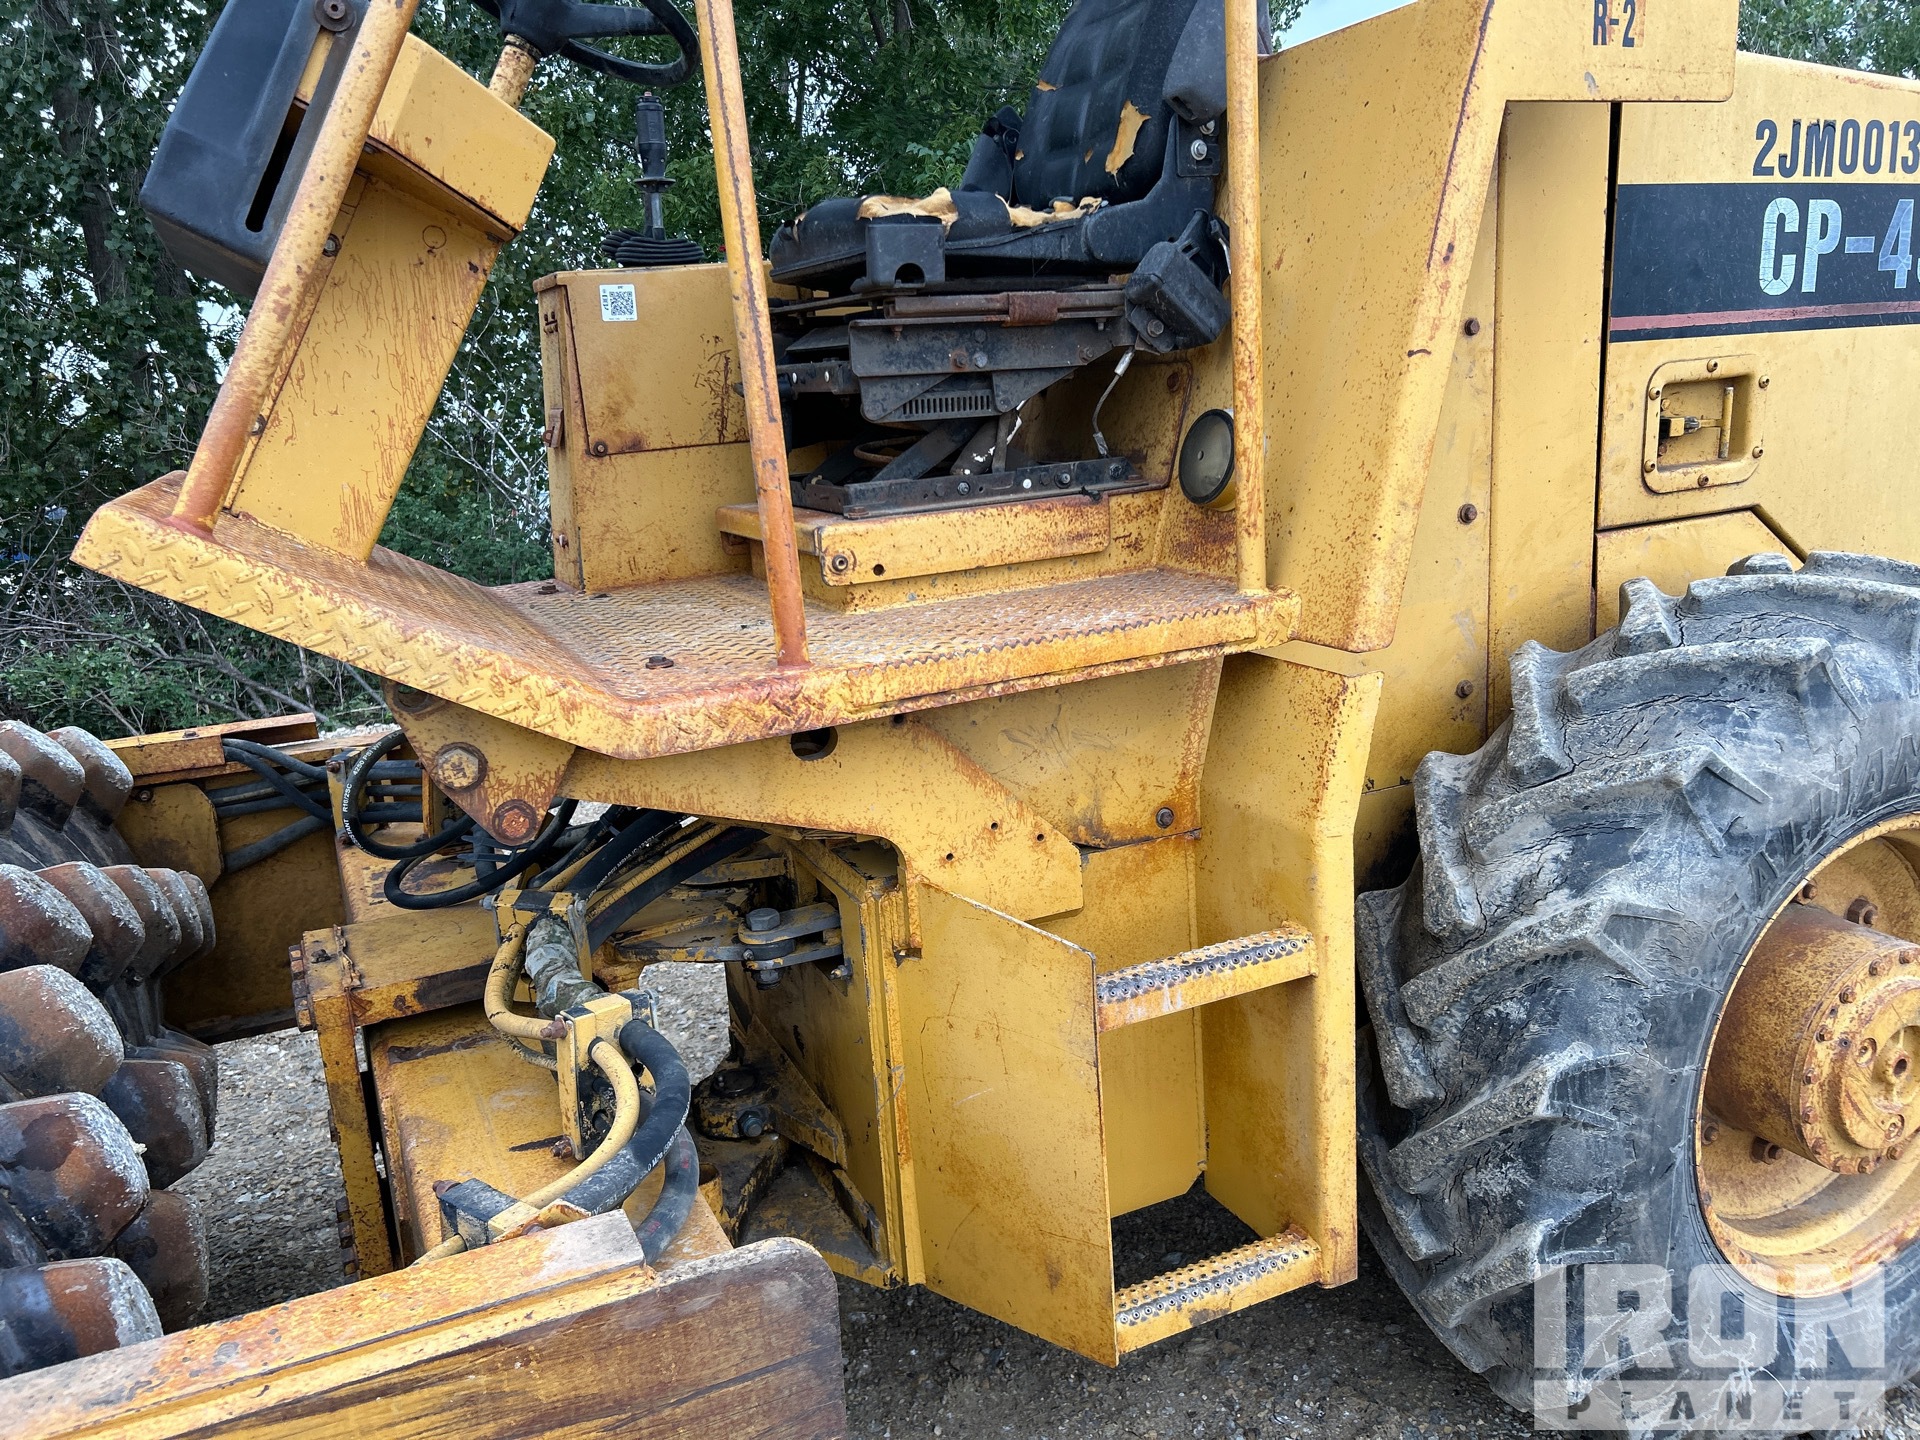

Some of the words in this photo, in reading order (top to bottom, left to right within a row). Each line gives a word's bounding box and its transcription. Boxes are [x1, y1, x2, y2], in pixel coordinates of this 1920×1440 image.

[1593, 0, 1635, 47] R-2
[1753, 119, 1920, 178] 2JM0013
[1759, 197, 1920, 296] CP-4
